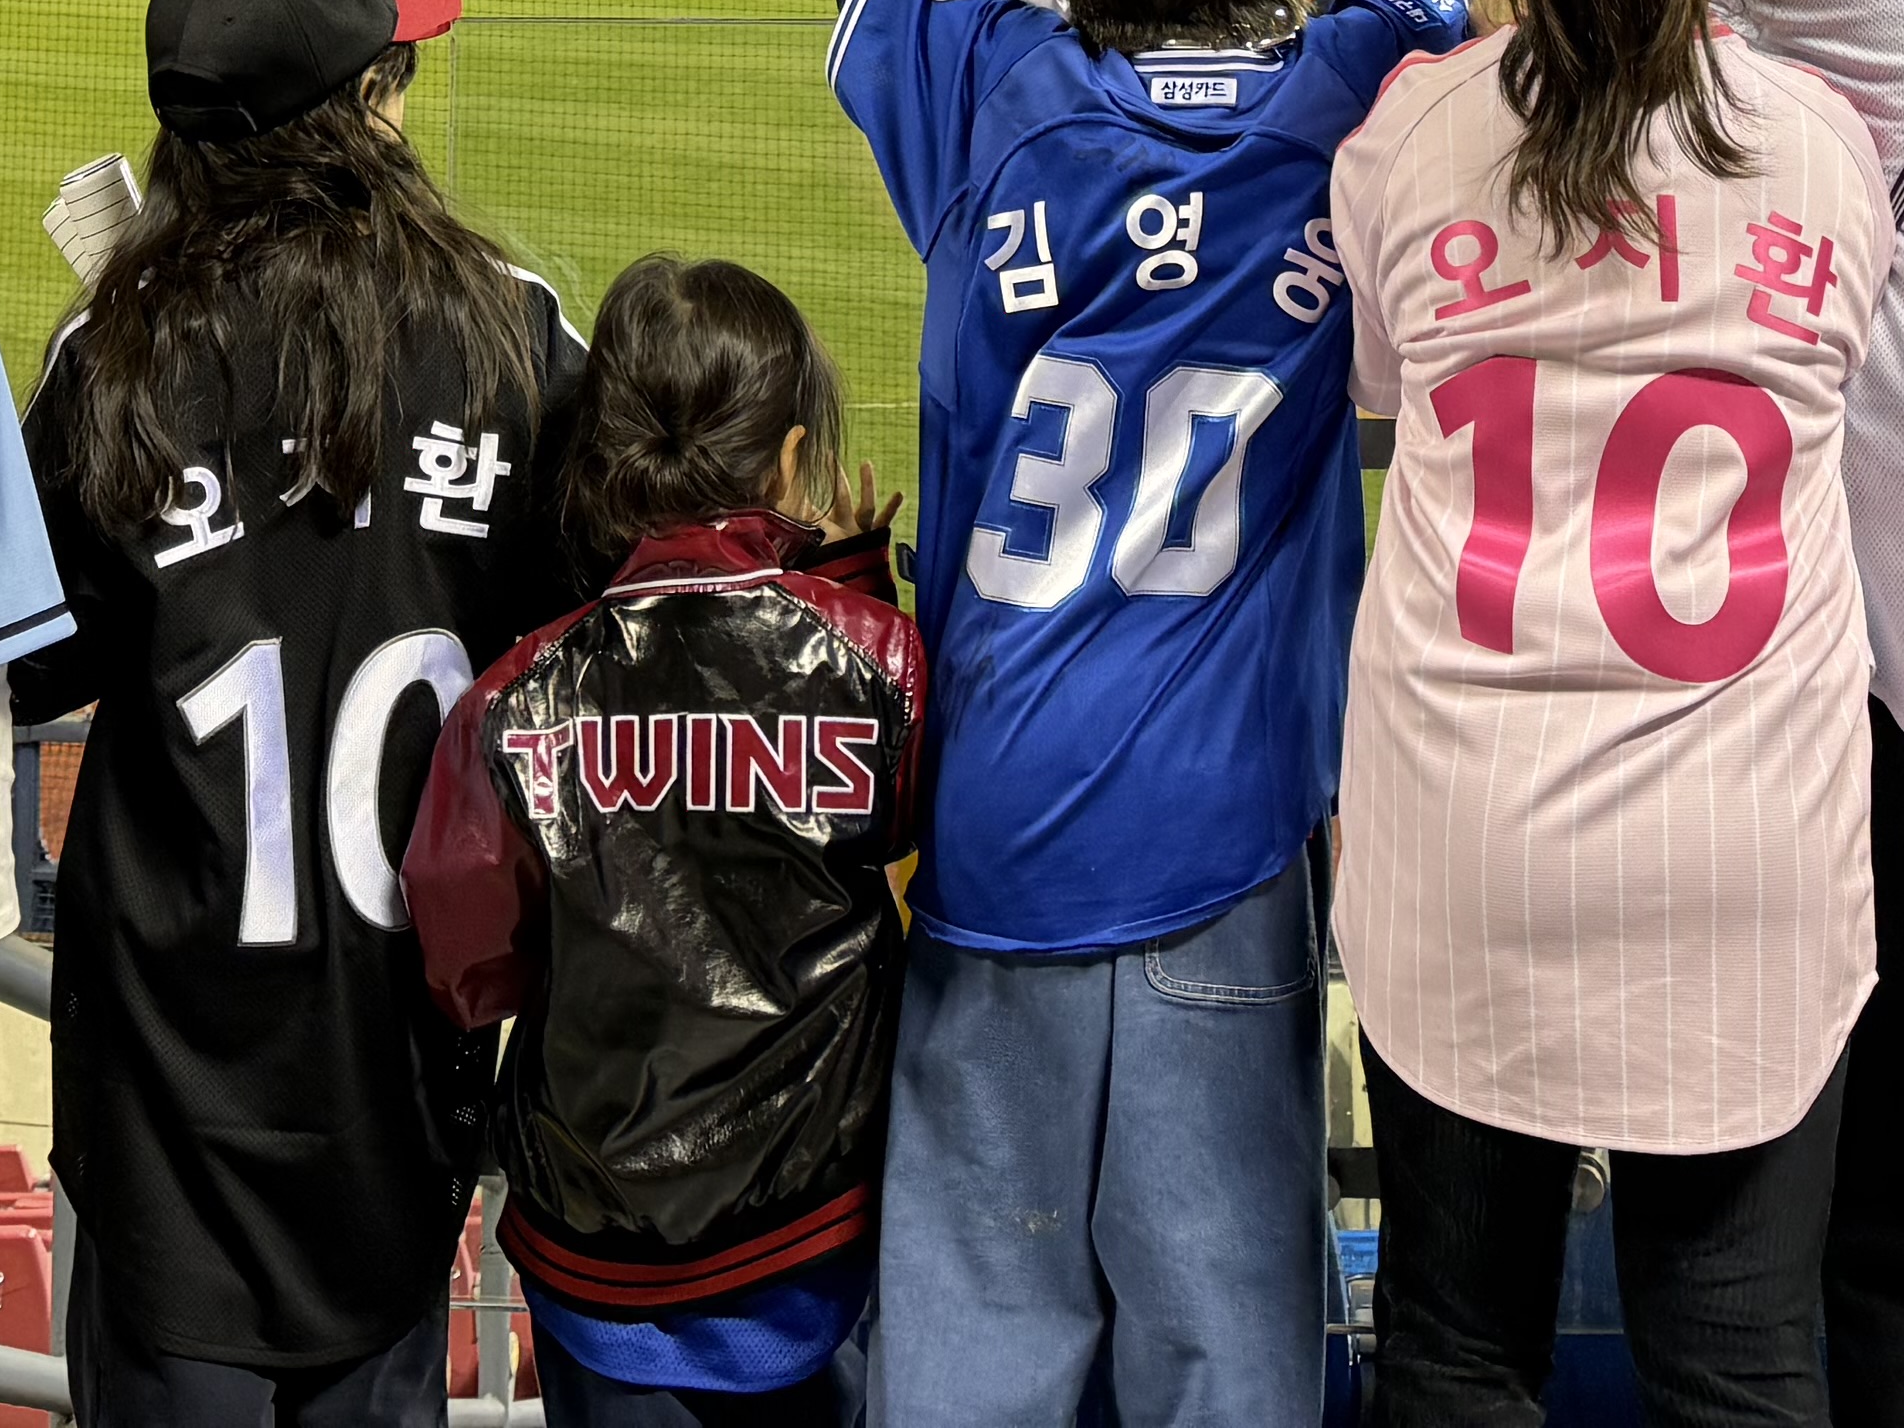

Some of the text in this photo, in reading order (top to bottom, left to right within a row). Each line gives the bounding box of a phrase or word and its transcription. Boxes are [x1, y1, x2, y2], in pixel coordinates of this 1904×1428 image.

[1159, 78, 1228, 105] 삼성카드
[964, 353, 1284, 613] 30
[1428, 356, 1795, 684] 10
[175, 629, 475, 947] 10
[503, 712, 881, 822] TWINS
